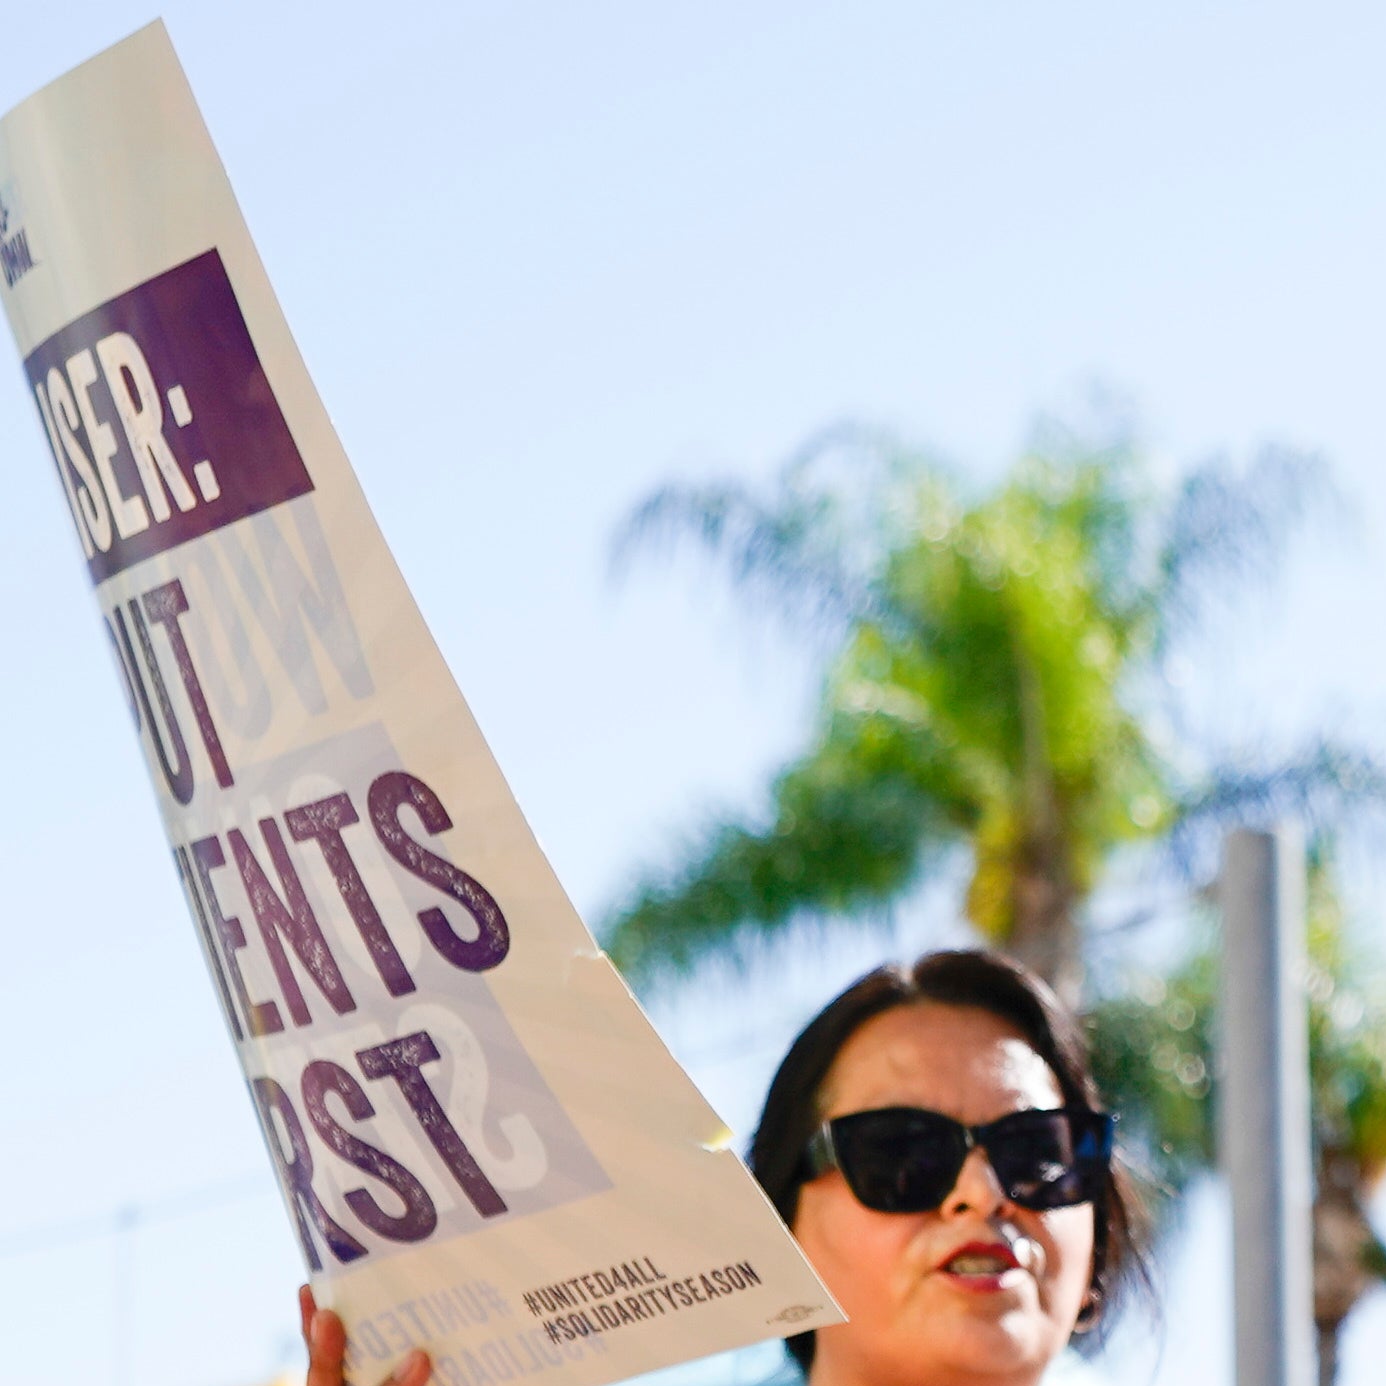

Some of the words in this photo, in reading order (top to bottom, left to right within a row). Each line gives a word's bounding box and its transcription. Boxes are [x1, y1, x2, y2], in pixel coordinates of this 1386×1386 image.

[104, 578, 235, 806] UT
[171, 771, 510, 1041] IENTS
[522, 1257, 668, 1317] #UNITED4ALL
[542, 1260, 762, 1345] #SOLIDARITYSEASON
